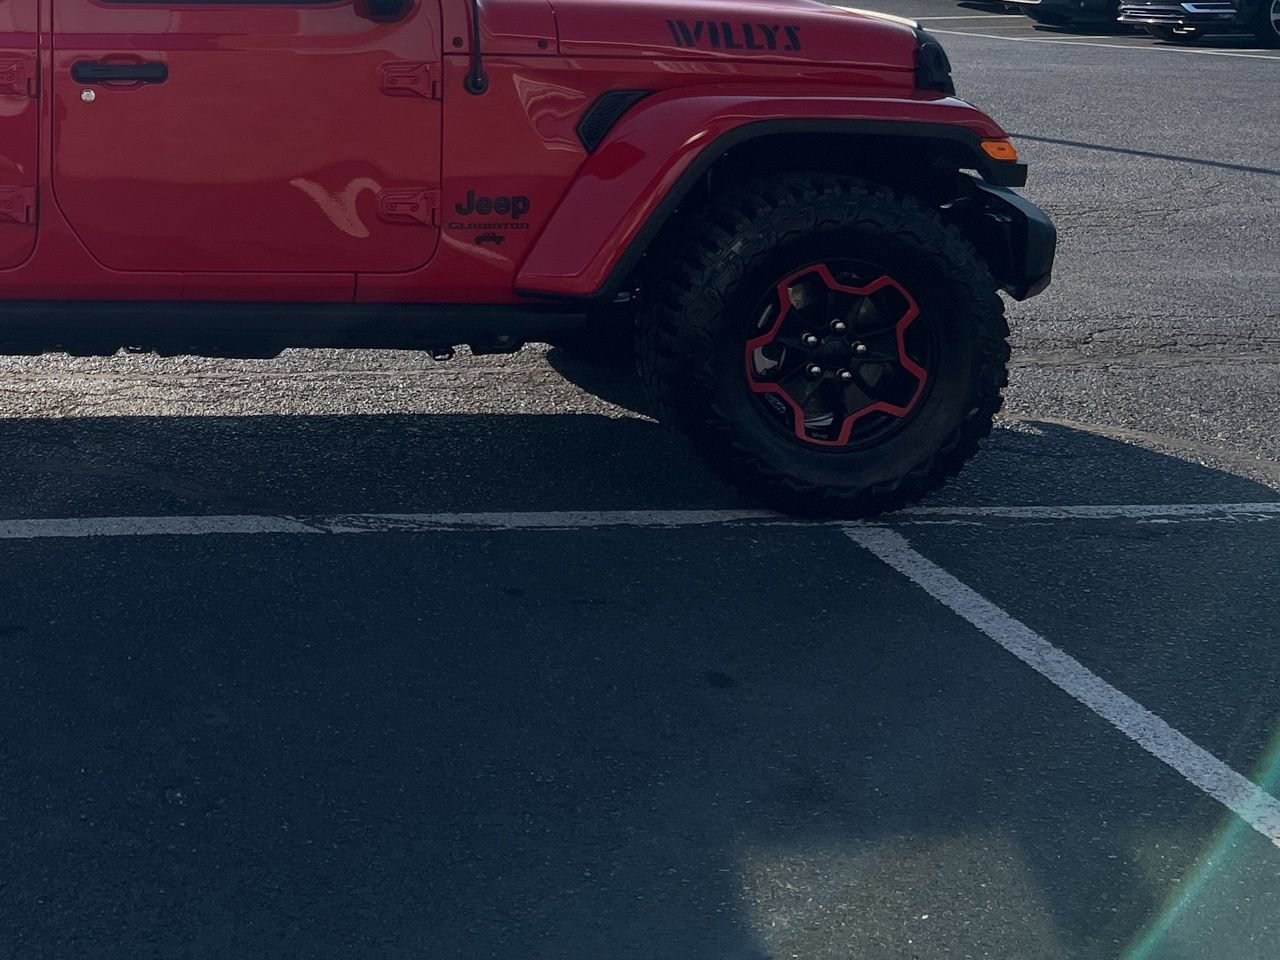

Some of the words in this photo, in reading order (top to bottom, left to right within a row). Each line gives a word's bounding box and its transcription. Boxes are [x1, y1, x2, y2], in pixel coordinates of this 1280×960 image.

[666, 19, 801, 51] WILLYS
[455, 191, 530, 219] Jeep
[448, 222, 529, 230] GLADIATOR
